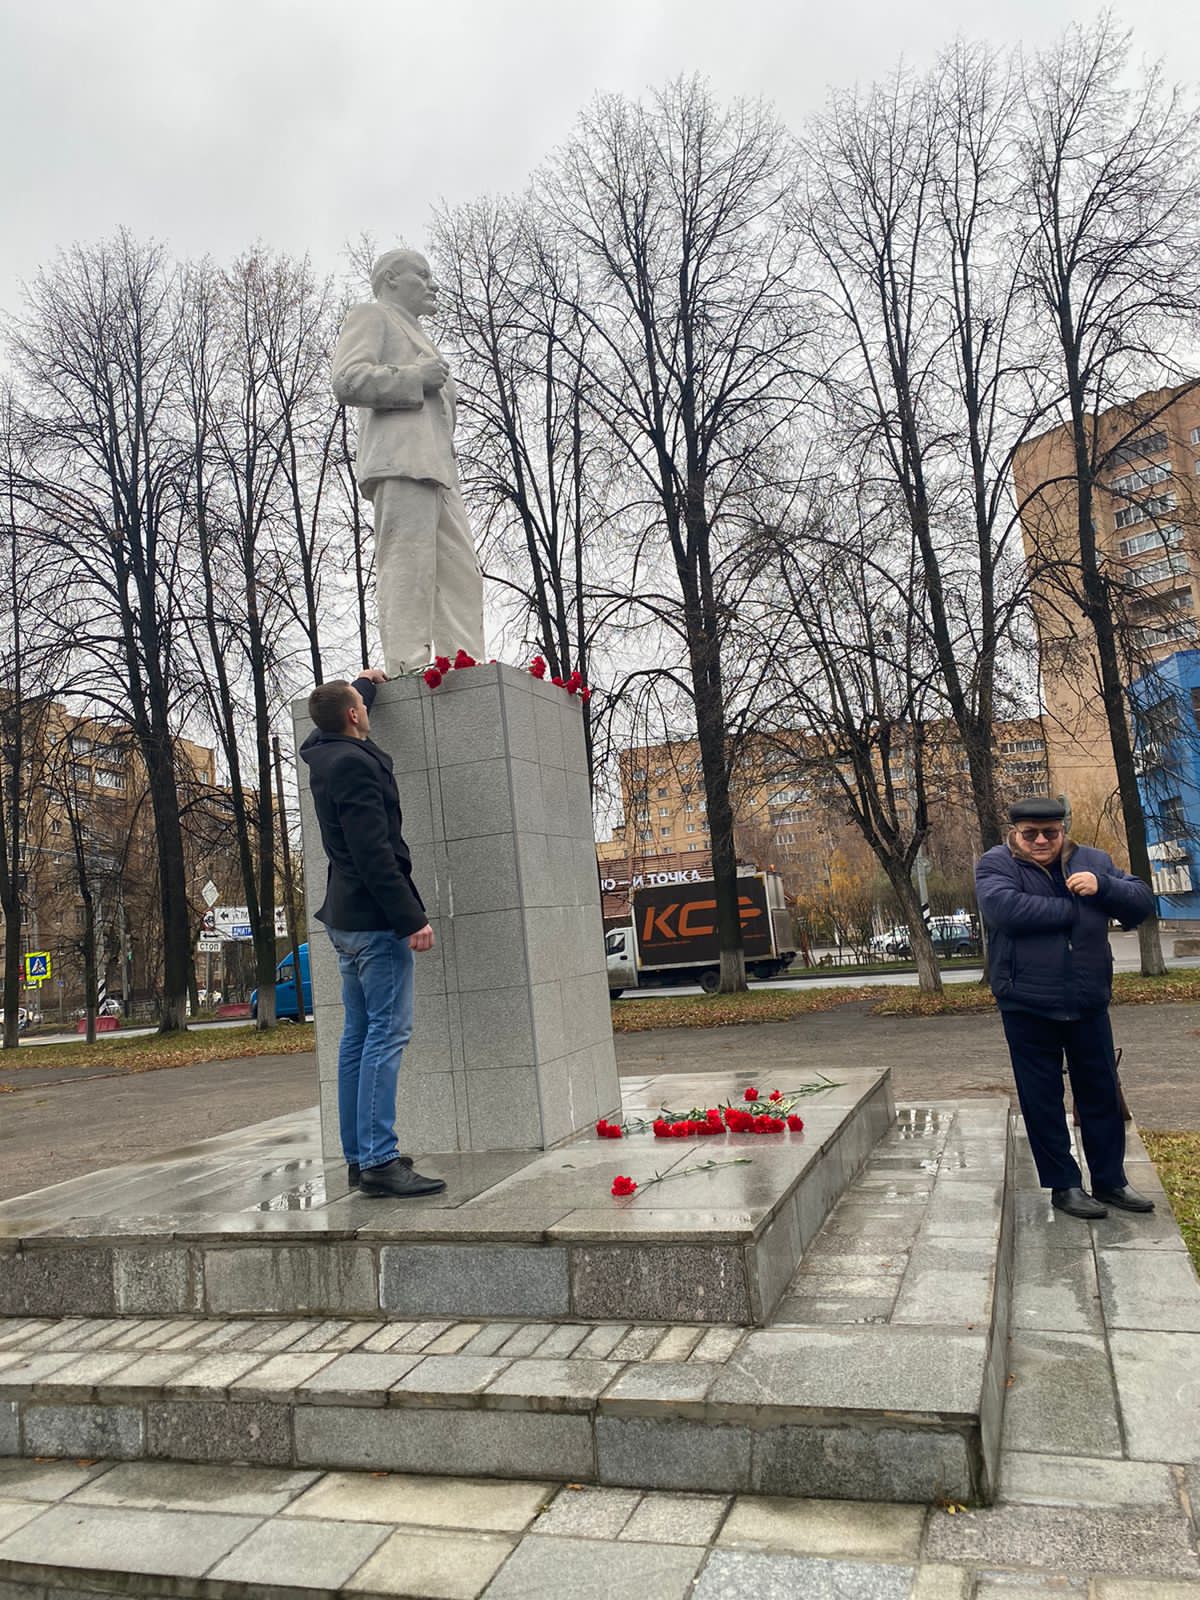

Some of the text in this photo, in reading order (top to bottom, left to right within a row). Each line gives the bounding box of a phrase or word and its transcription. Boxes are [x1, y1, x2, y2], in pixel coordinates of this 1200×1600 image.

[632, 874, 644, 888] И
[647, 869, 701, 885] ТОЧКА
[233, 927, 252, 936] ДМИТР
